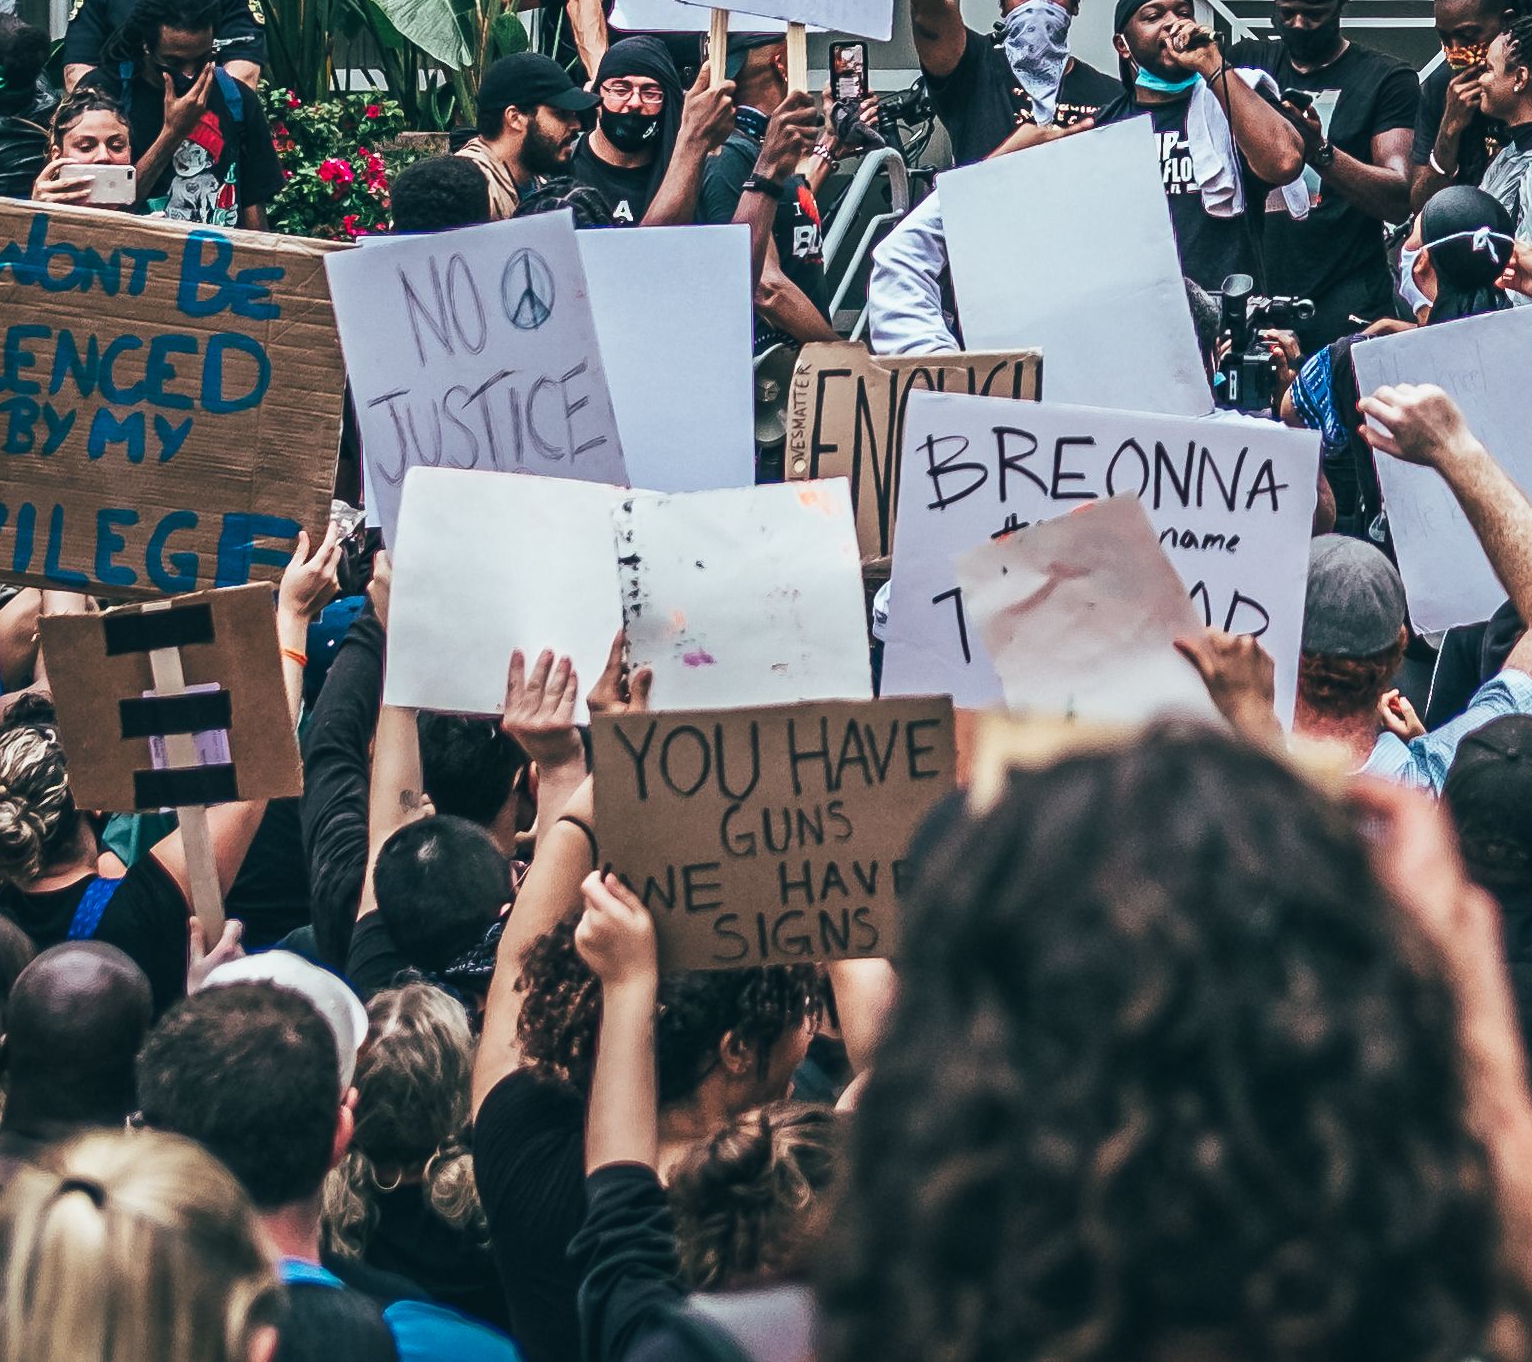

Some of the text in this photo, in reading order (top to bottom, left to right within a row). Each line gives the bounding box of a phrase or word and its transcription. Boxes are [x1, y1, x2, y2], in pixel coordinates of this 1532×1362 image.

[177, 230, 286, 320] BE
[397, 252, 487, 368] NO
[88, 408, 194, 464] MY
[368, 361, 609, 486] JUSTICE
[916, 424, 1287, 513] BREONNA
[613, 715, 942, 802] YOU HAVE
[720, 799, 854, 858] GUNS
[711, 906, 880, 962] SIGNS
